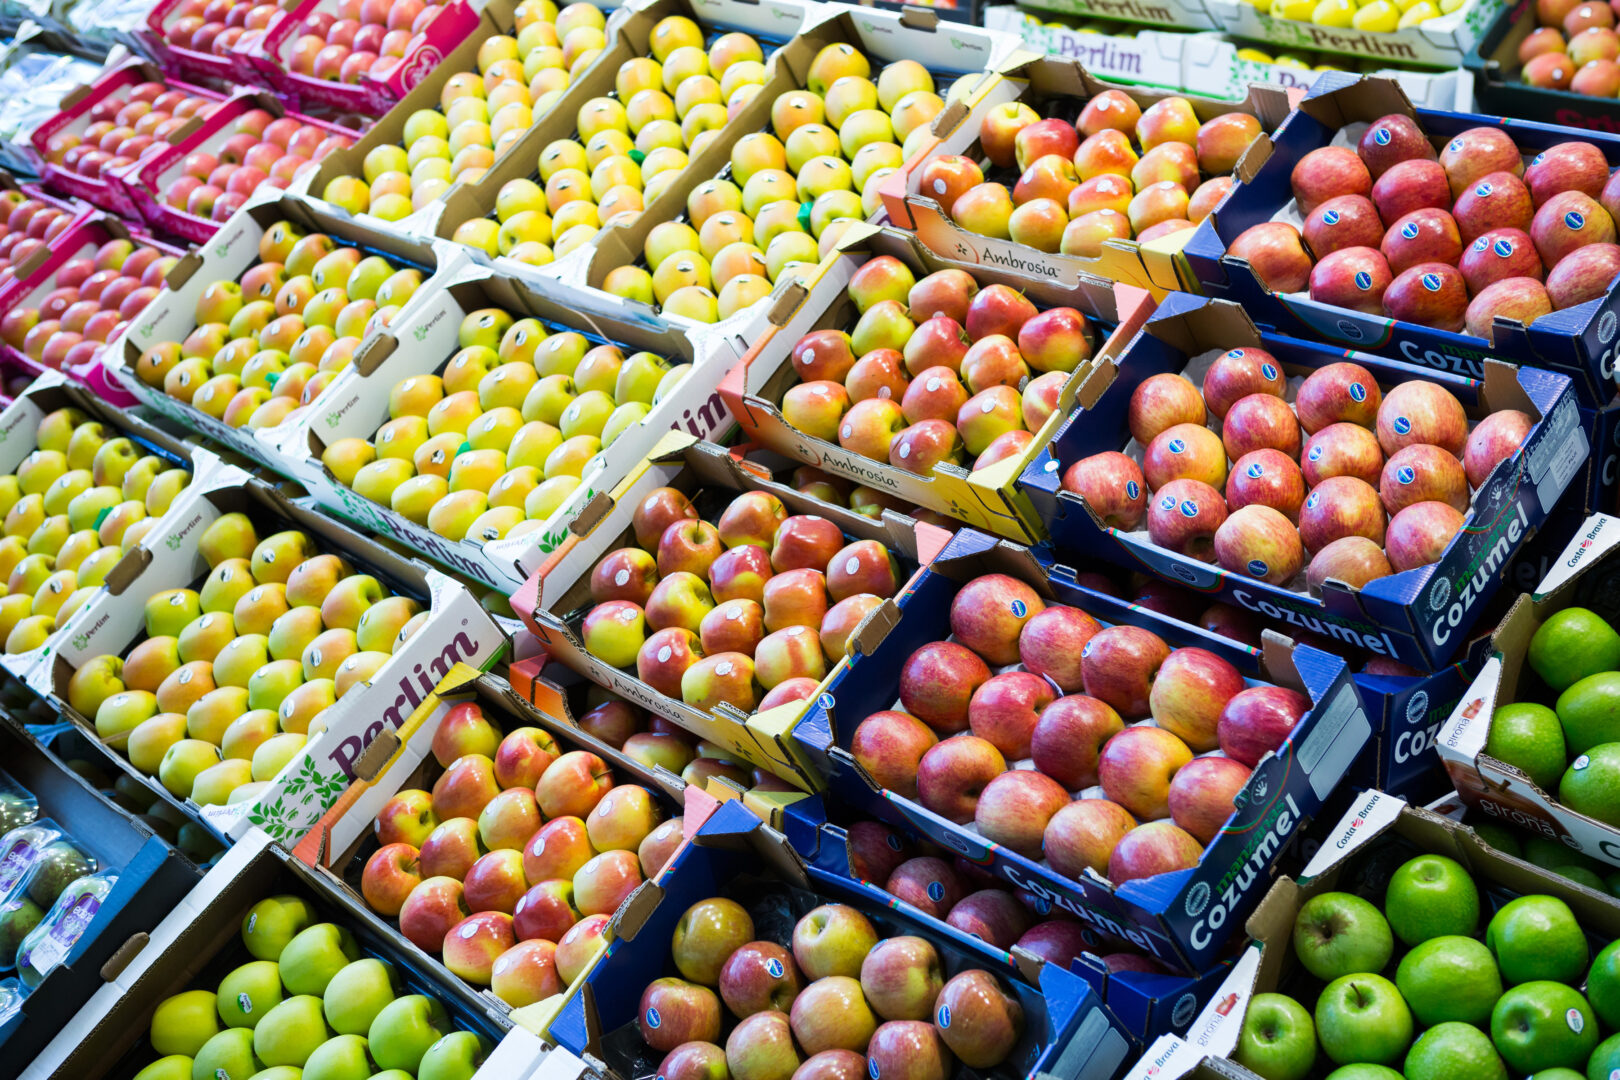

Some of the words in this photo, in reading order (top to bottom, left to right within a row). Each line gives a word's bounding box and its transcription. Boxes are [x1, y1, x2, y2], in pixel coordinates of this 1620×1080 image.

[1060, 36, 1142, 73] Perlim
[1309, 27, 1418, 59] Perlim
[983, 247, 1058, 278] Ambrosia
[823, 452, 897, 488] Ambrosia
[376, 510, 498, 586] Perlim
[1455, 505, 1516, 593] manzanas
[1567, 547, 1587, 568] Costa
[1586, 517, 1608, 540] Brava
[1432, 500, 1529, 646] Cozumel
[1232, 589, 1400, 660] Cozumel
[614, 678, 684, 721] Ambrosia
[1446, 718, 1470, 748] girona
[1336, 826, 1357, 849] Costa
[1358, 794, 1380, 820] Brava
[1479, 799, 1557, 838] girona
[1190, 793, 1301, 951] Cozumel
[1215, 799, 1286, 895] manzanas
[1002, 865, 1162, 958] Cozumel
[1154, 1041, 1180, 1068] Brava
